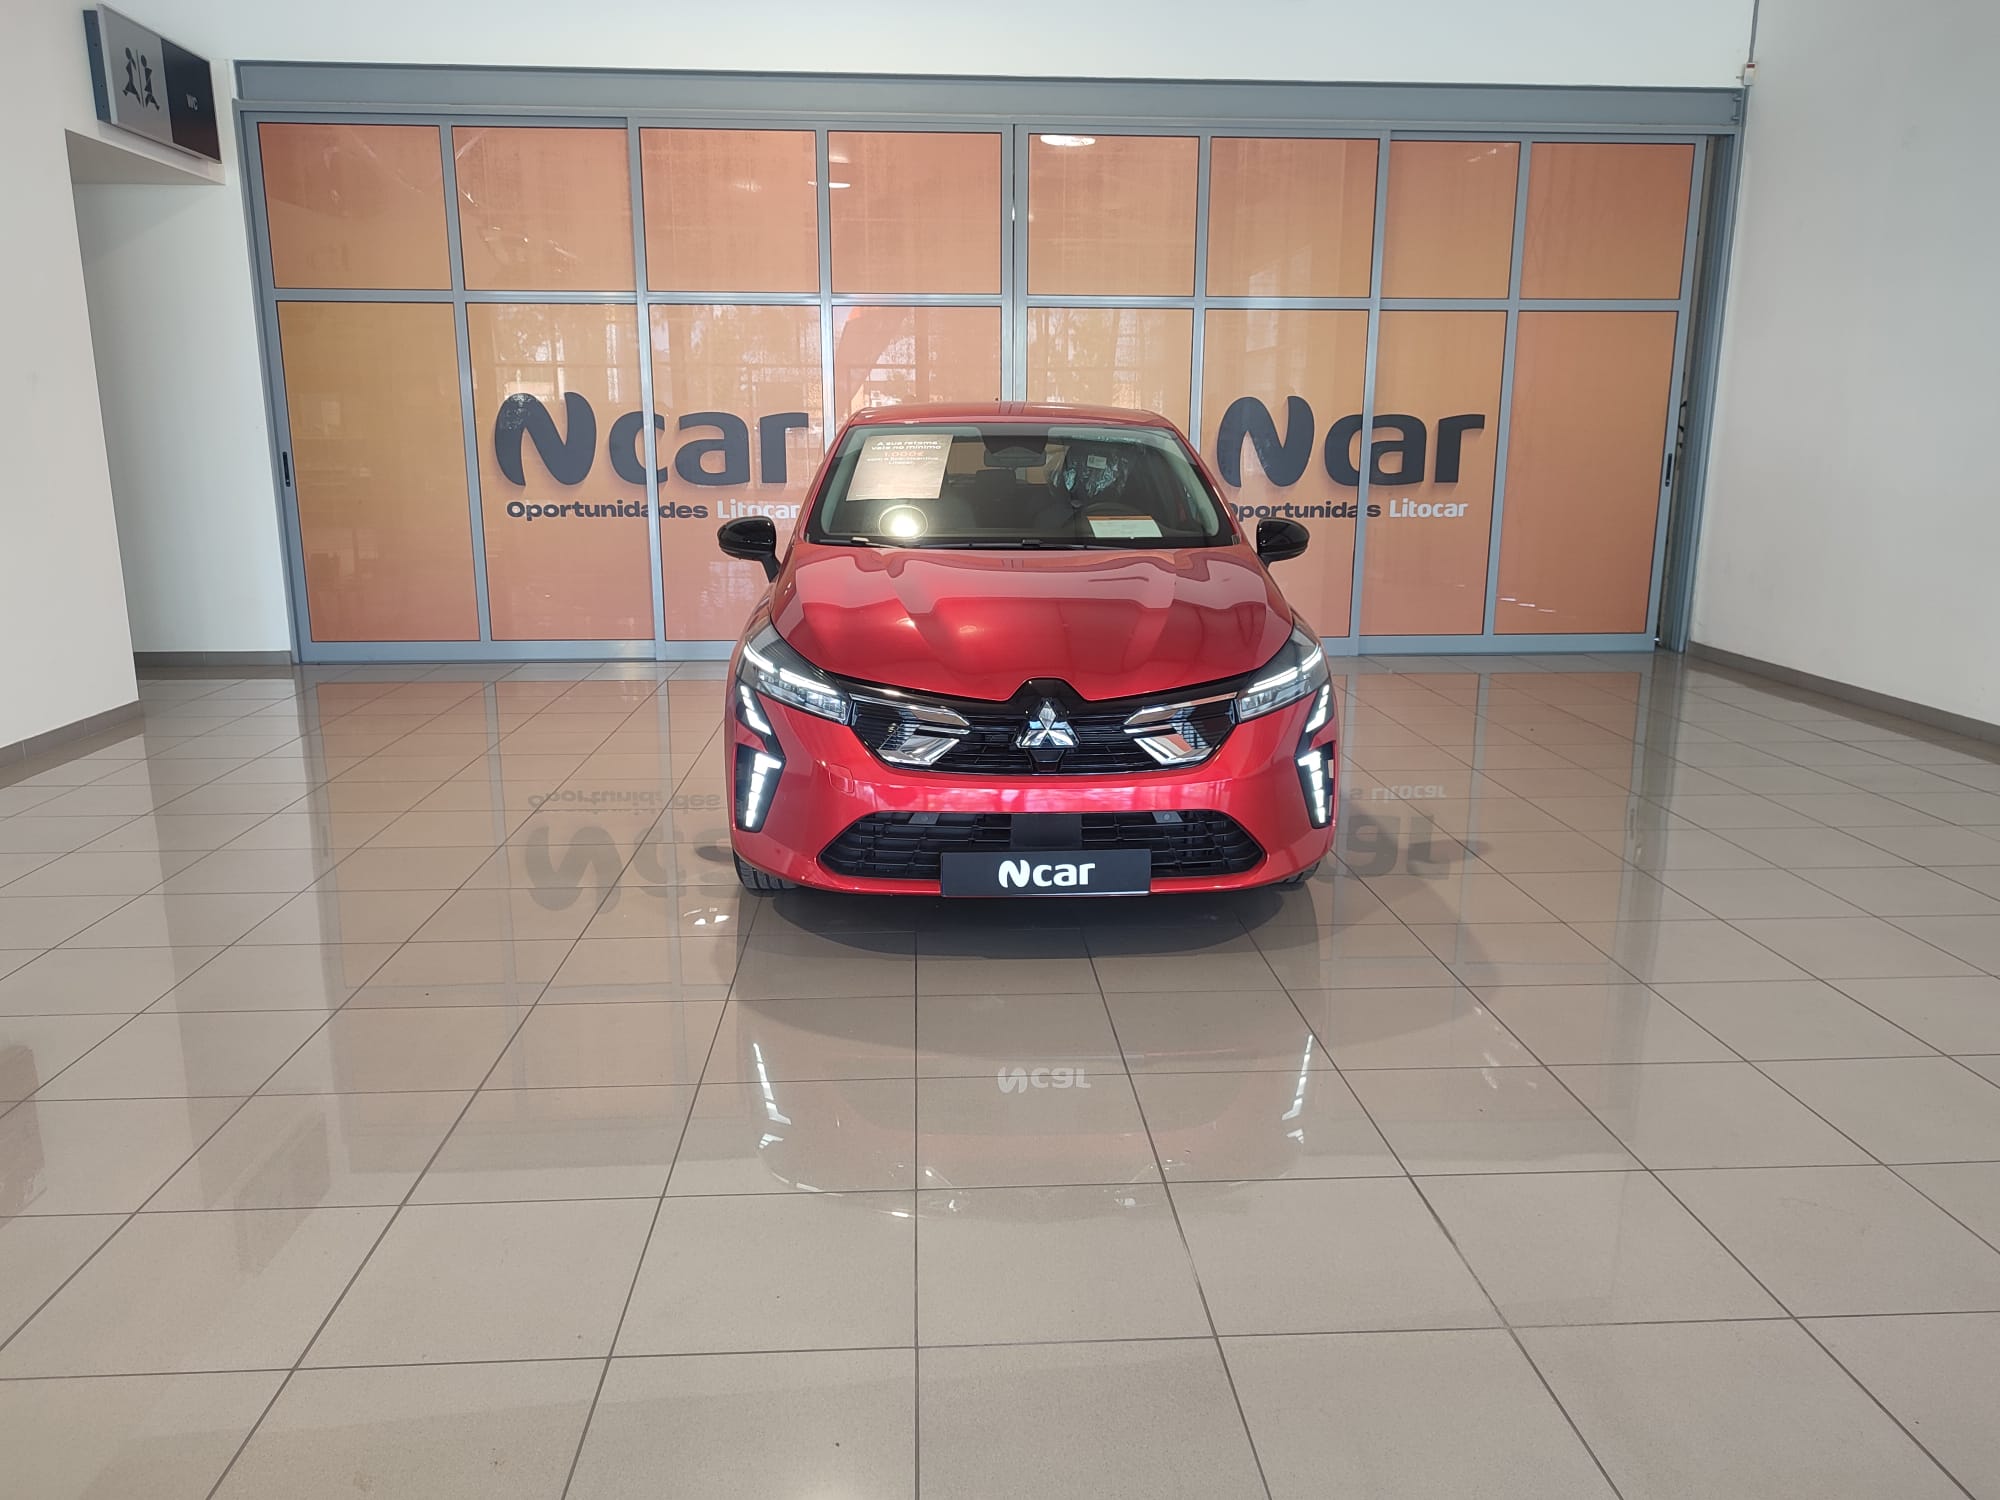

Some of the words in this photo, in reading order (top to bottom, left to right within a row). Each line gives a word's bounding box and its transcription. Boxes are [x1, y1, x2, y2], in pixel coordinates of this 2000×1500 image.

[494, 391, 809, 487] Ncar
[1216, 395, 1485, 487] Ncar
[507, 500, 708, 521] Oportunidades
[717, 499, 800, 519] Litocar
[1389, 498, 1468, 518] Litocar
[998, 859, 1096, 888] Ncar
